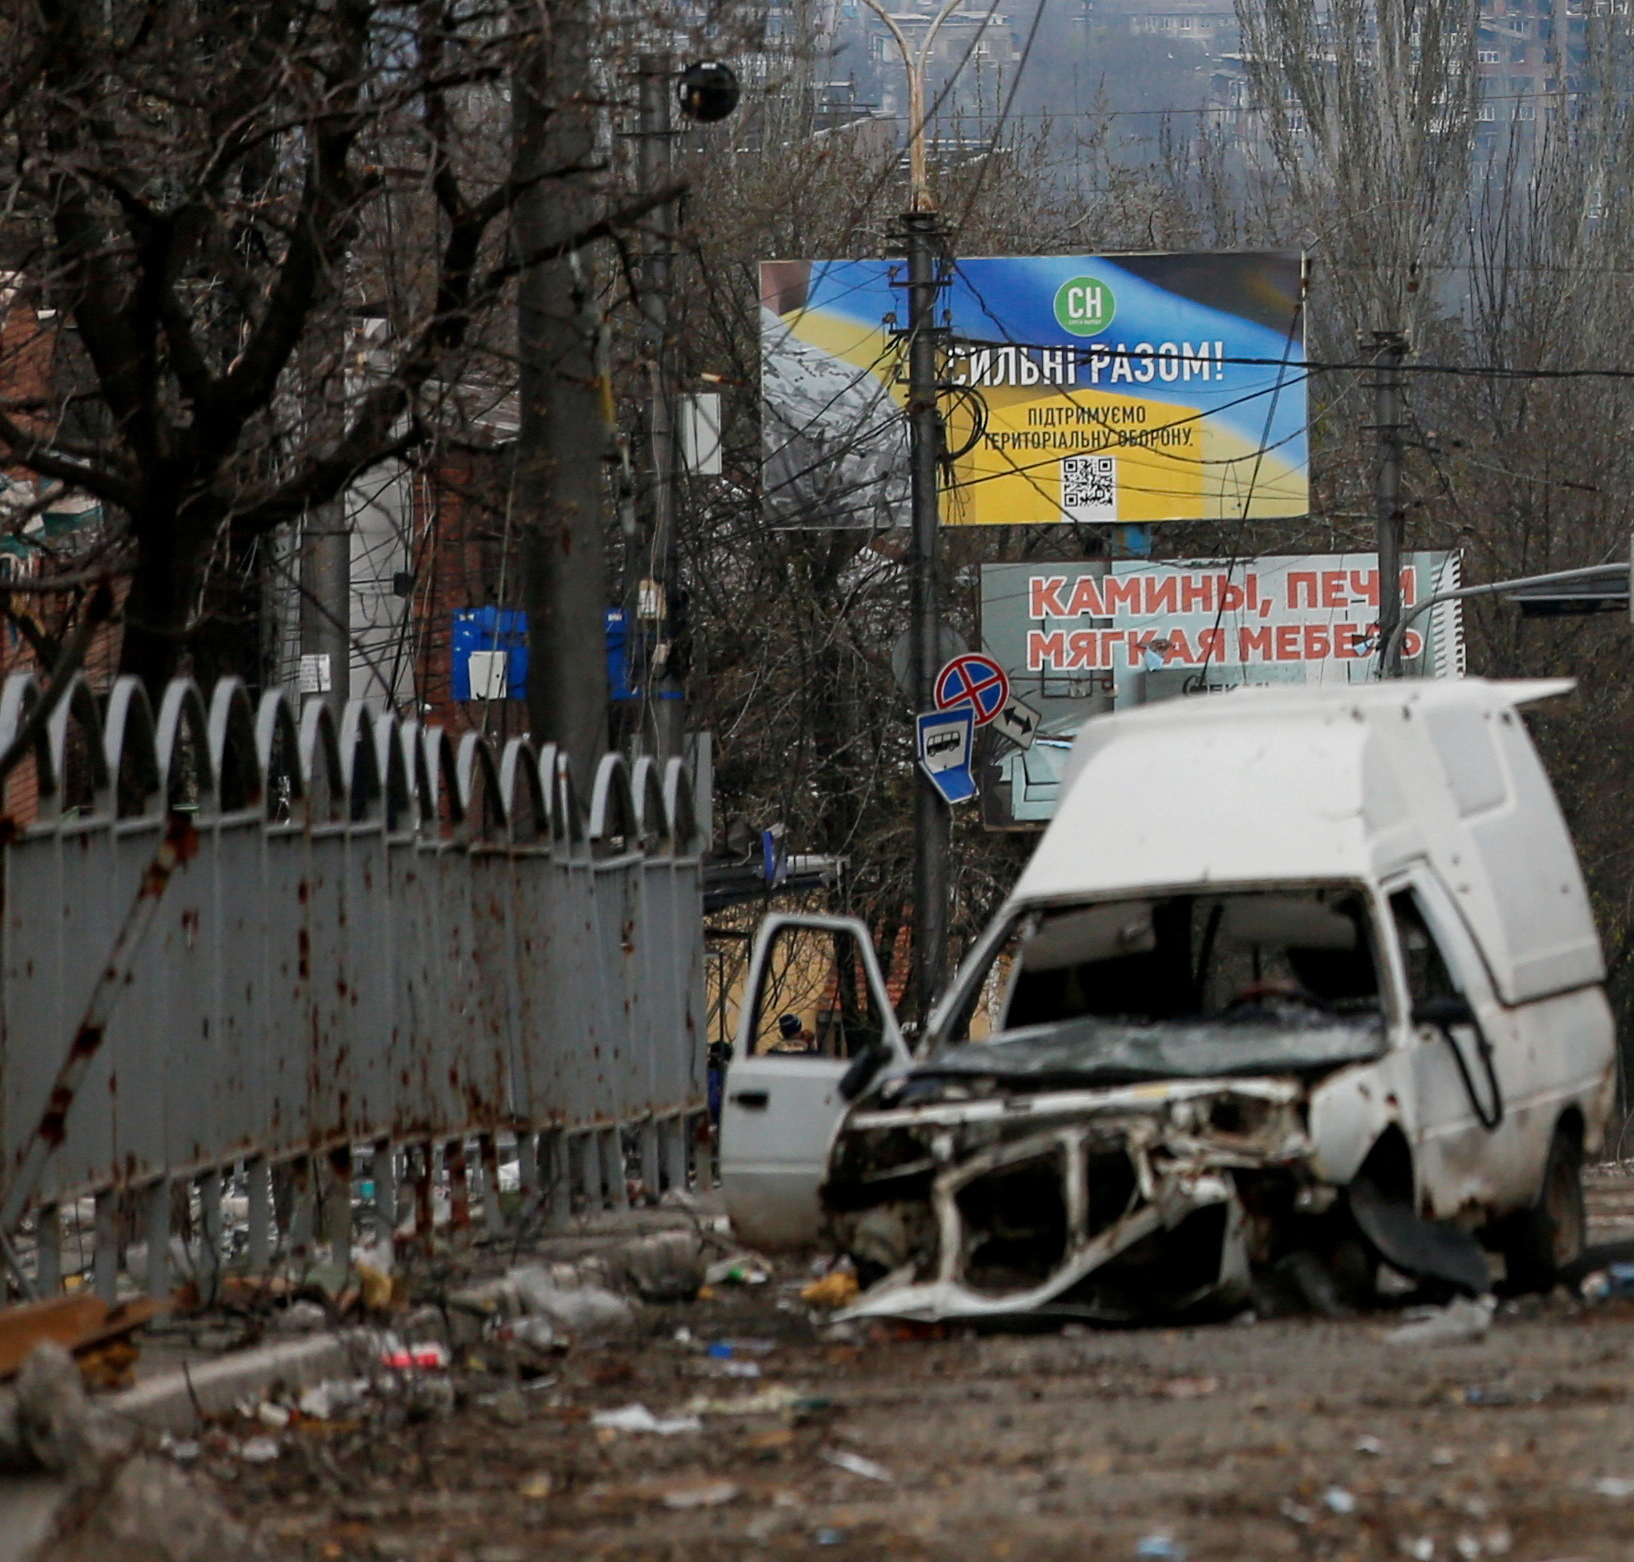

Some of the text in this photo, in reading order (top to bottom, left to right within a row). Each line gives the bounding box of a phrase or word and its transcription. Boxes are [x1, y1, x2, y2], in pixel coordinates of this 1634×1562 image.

[1068, 287, 1102, 318] СН
[947, 341, 1225, 387] СИЛЬНІ РАЗОМ!
[1027, 405, 1147, 429] ПІДТРИМУЄМО
[984, 428, 1113, 451] ТЕРИТОРІАЛЬНУ
[1029, 572, 1274, 620] КАМИНЫ,
[1028, 625, 1227, 670] МЯГКАЯ
